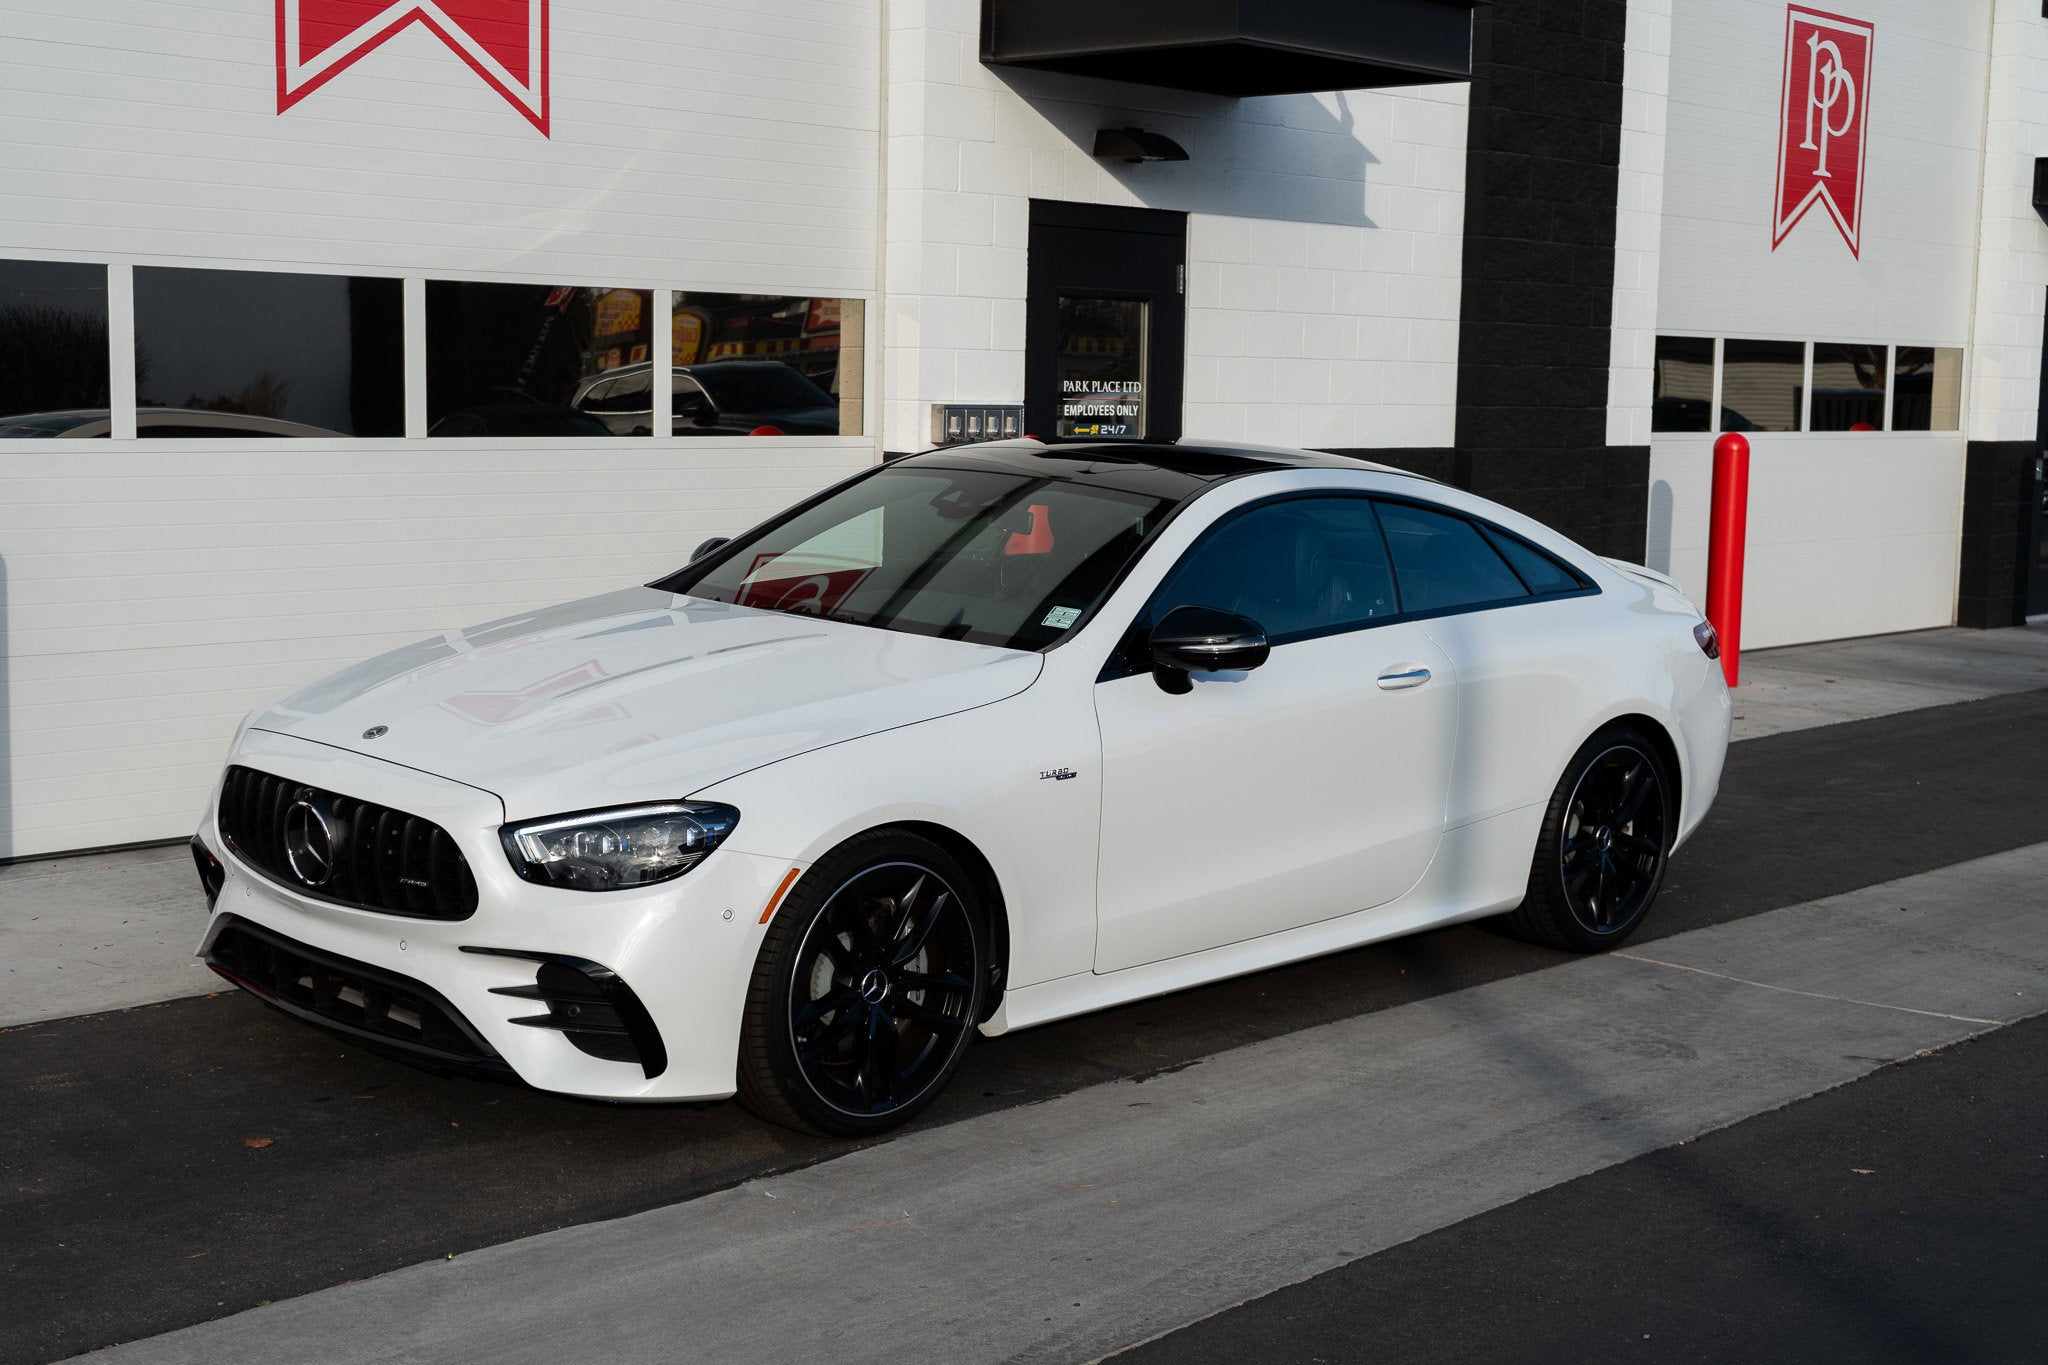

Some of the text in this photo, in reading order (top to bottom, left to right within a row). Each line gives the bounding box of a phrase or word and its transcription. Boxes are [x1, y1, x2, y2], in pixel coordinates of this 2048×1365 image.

[1063, 380, 1142, 393] PARK PLACE LTD
[1064, 404, 1139, 416] EMPLOYEES ONLY
[1100, 425, 1127, 434] 24/7
[1040, 767, 1069, 778] TURBO
